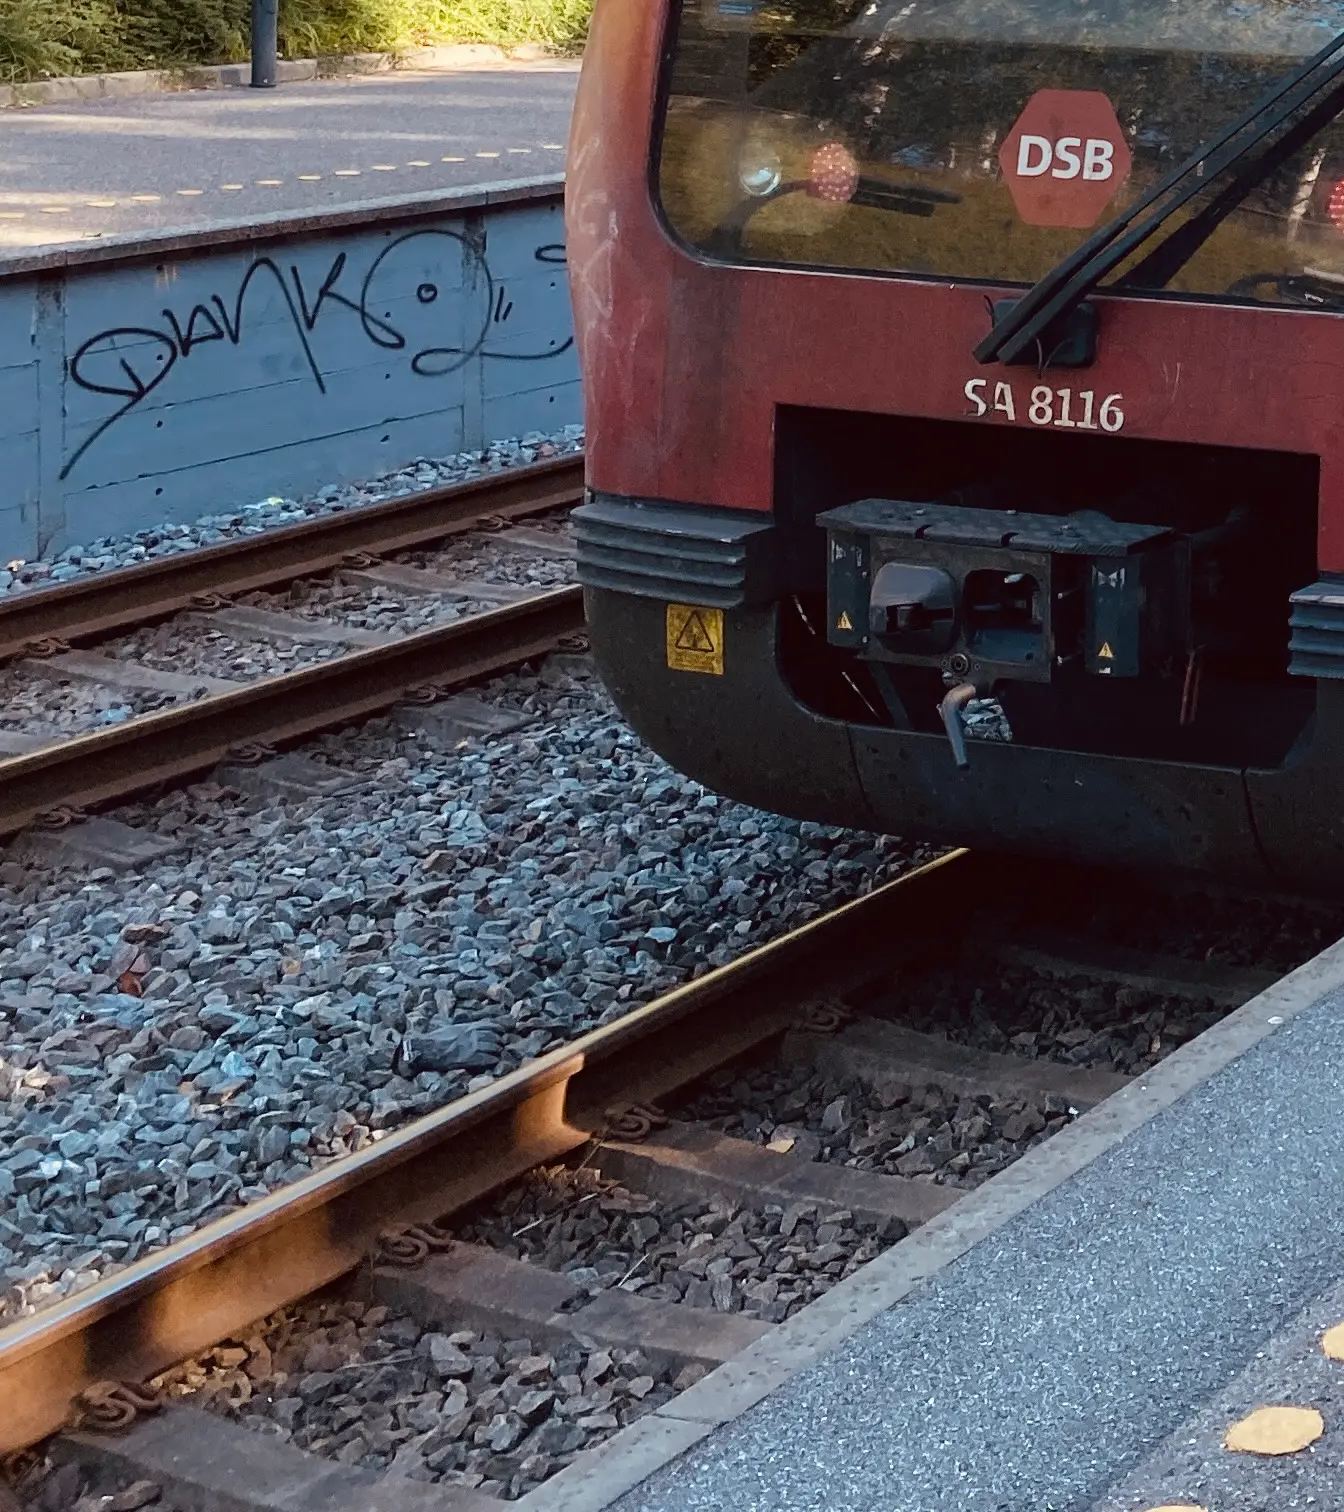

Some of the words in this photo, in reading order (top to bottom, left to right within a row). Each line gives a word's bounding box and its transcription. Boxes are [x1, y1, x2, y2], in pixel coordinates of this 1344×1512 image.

[1016, 134, 1115, 182] DSB
[965, 378, 1016, 422] SA
[1028, 385, 1124, 432] 8116
